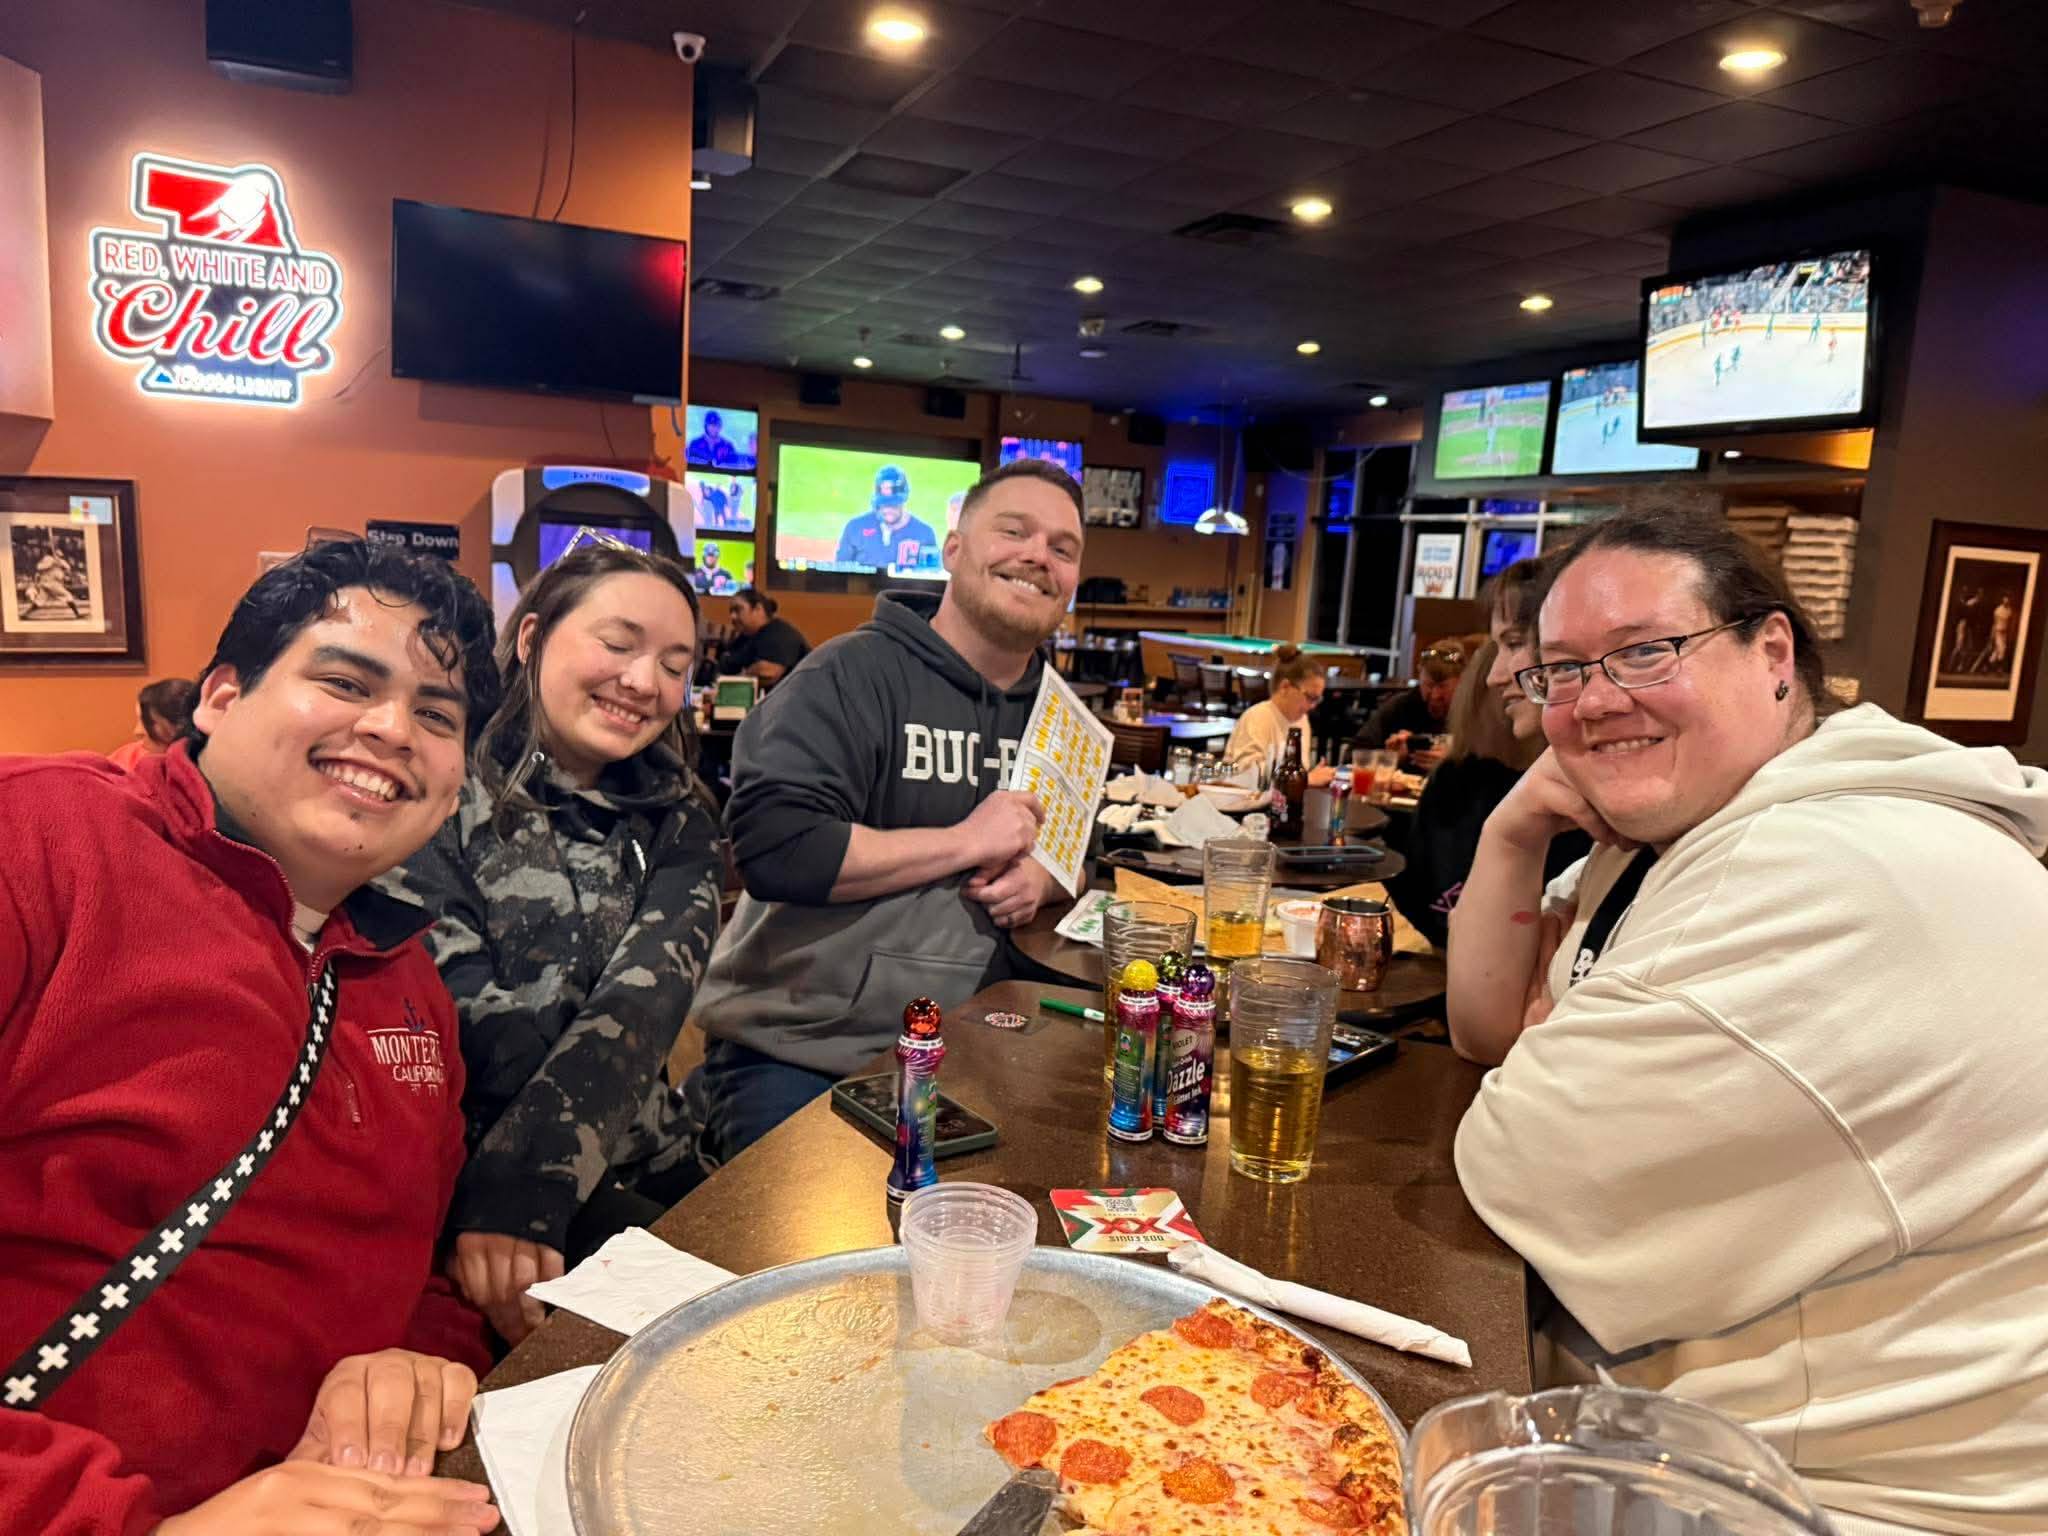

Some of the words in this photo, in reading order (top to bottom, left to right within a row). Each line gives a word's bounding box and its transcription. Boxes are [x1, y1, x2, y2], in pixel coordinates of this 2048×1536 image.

[171, 245, 267, 288] WHITE
[270, 256, 331, 294] AND
[101, 280, 334, 368] Chill
[411, 532, 459, 548] Down
[1166, 1057, 1206, 1095] Dazzle
